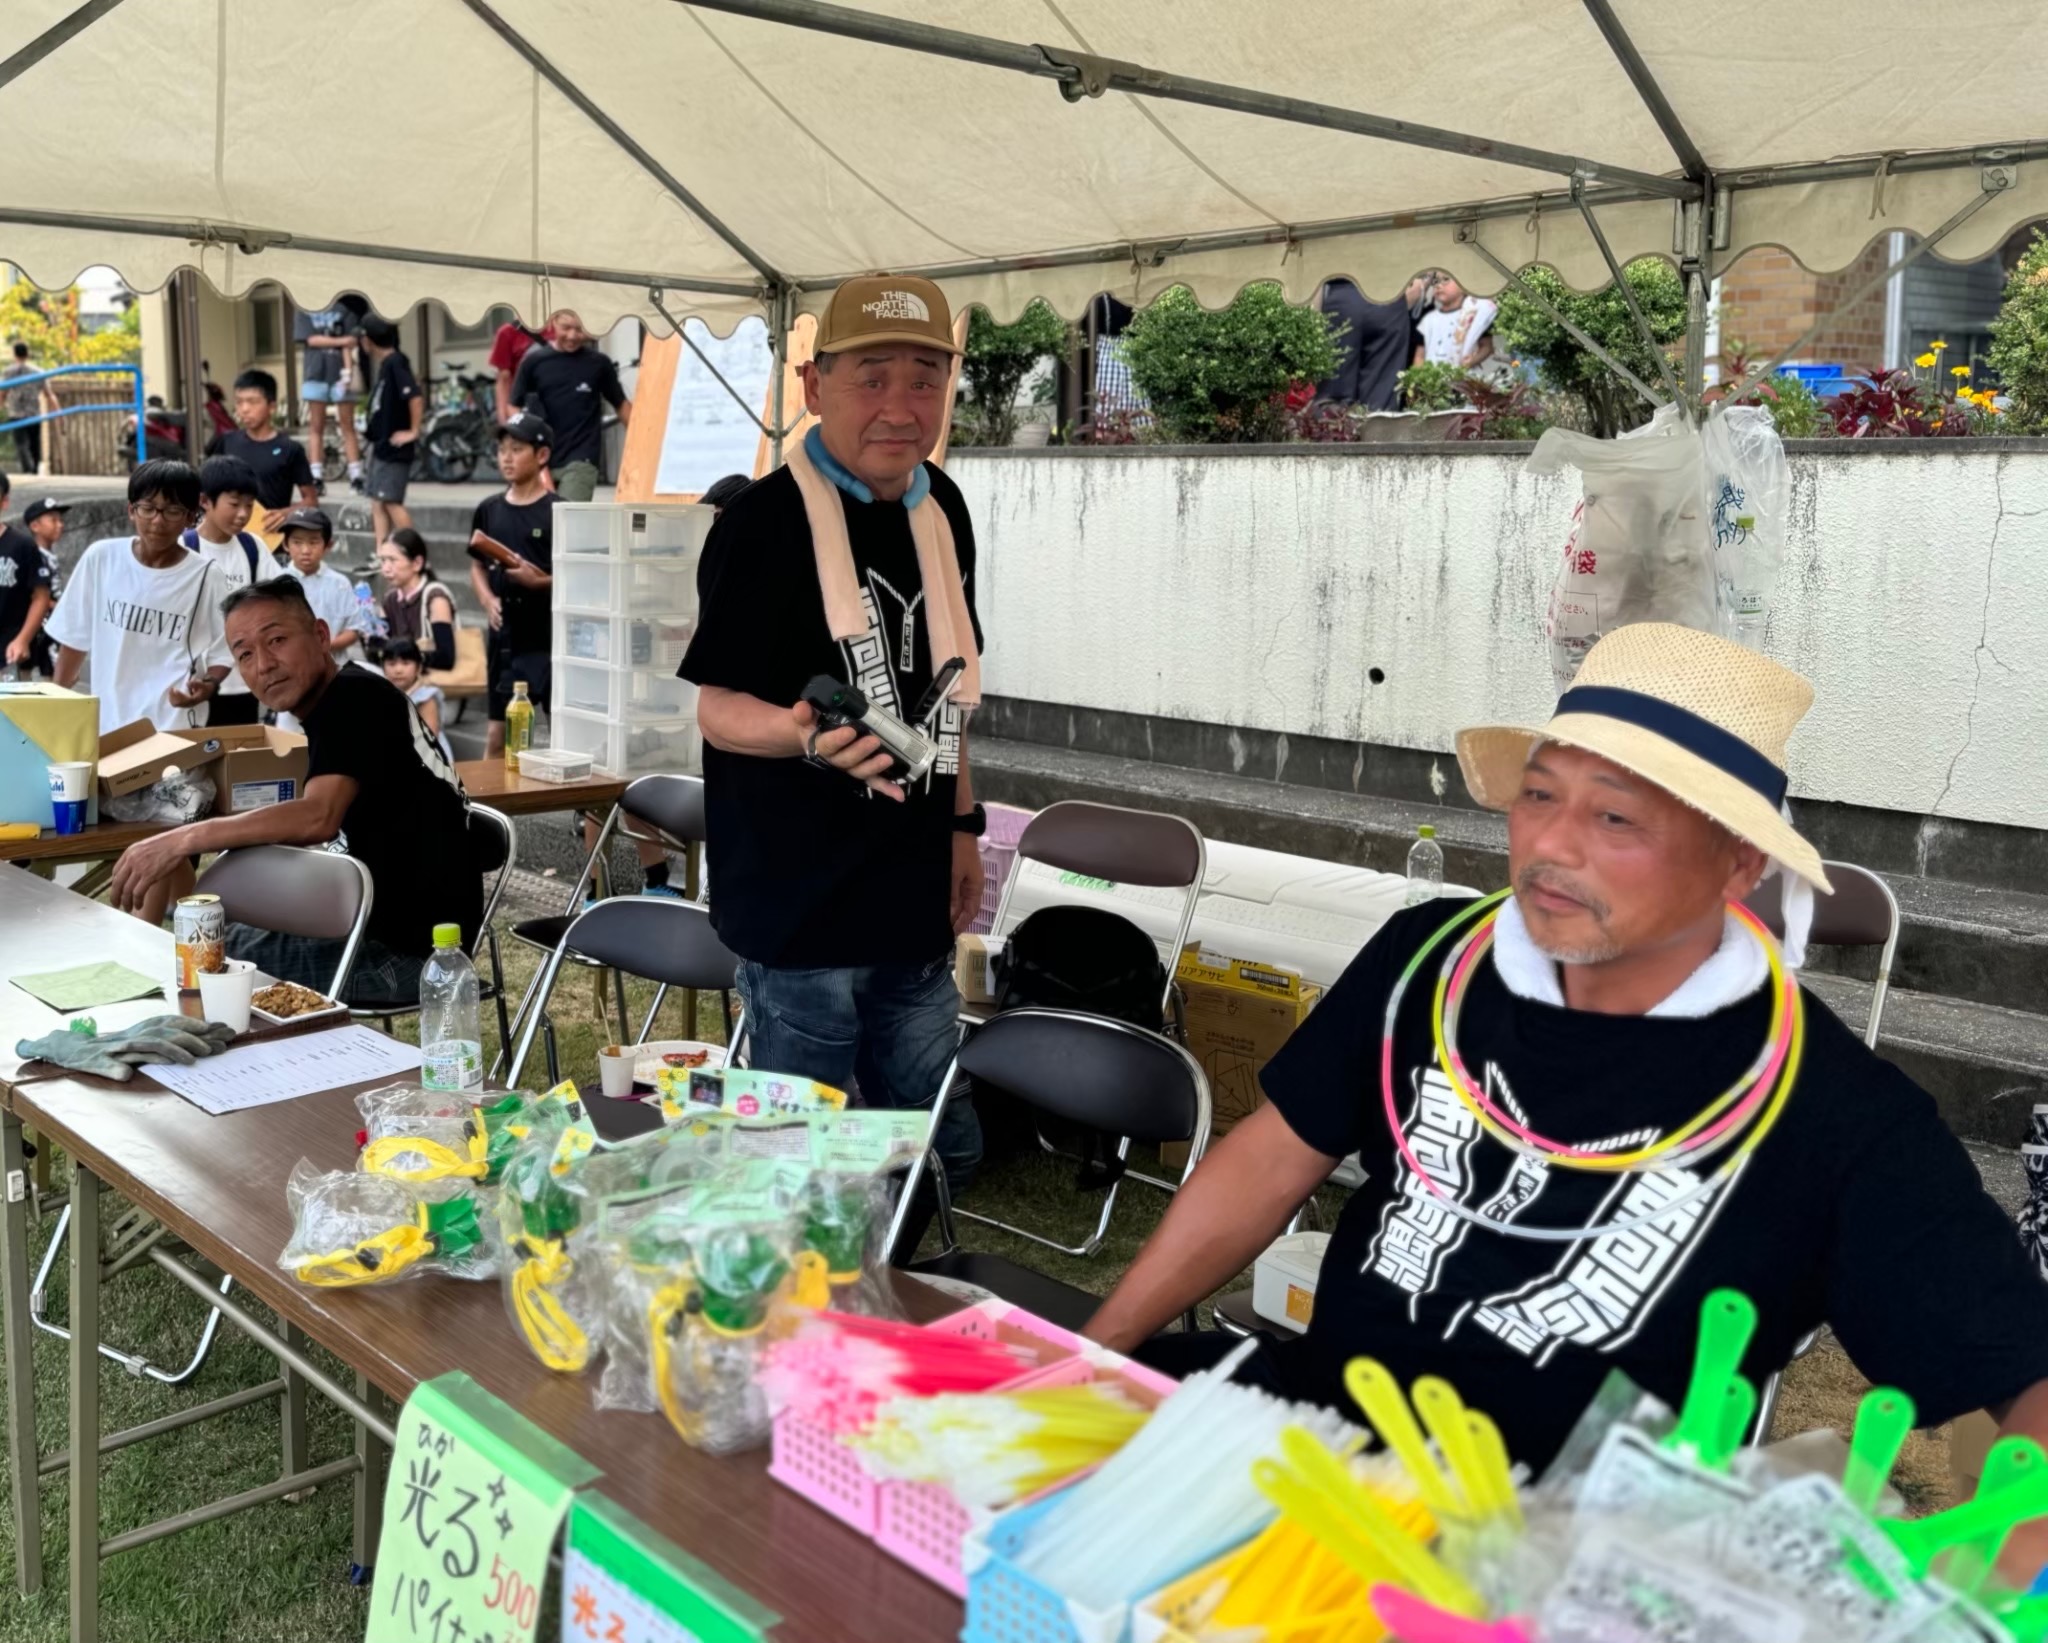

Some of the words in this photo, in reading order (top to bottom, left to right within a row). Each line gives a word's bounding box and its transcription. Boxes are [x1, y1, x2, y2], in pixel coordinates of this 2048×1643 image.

[862, 300, 907, 313] NORTH
[880, 291, 907, 301] THE
[876, 309, 909, 320] FACE
[104, 598, 187, 641] ACHIEVE
[400, 1457, 480, 1578] 光る
[484, 1553, 537, 1631] 500
